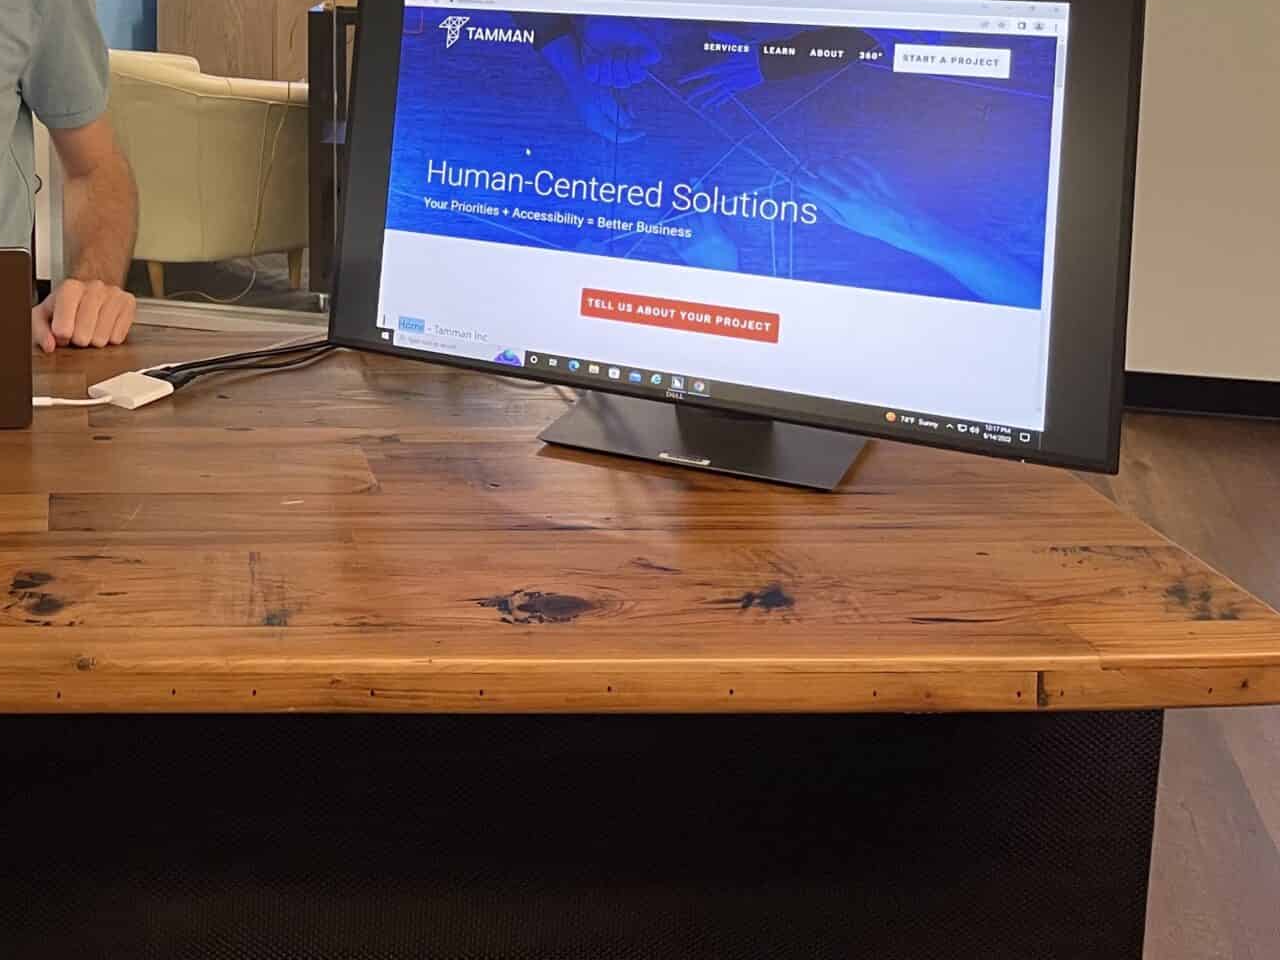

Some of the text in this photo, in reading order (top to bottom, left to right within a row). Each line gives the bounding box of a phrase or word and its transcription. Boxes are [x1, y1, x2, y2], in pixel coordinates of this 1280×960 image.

[466, 26, 535, 44] TAMMAN
[703, 42, 750, 54] SERVICES
[763, 45, 796, 56] LEARN
[809, 48, 845, 59] ABOUT
[902, 53, 1000, 68] START A PROJECT
[426, 159, 818, 225] Human-Centered Solutions
[423, 196, 449, 210] Your
[450, 198, 500, 217] Priorities
[511, 206, 585, 228] Accessibility
[597, 216, 634, 233] Better
[636, 220, 693, 240] Business
[587, 297, 772, 332] TELL US ABOUT YOUR PROJECT
